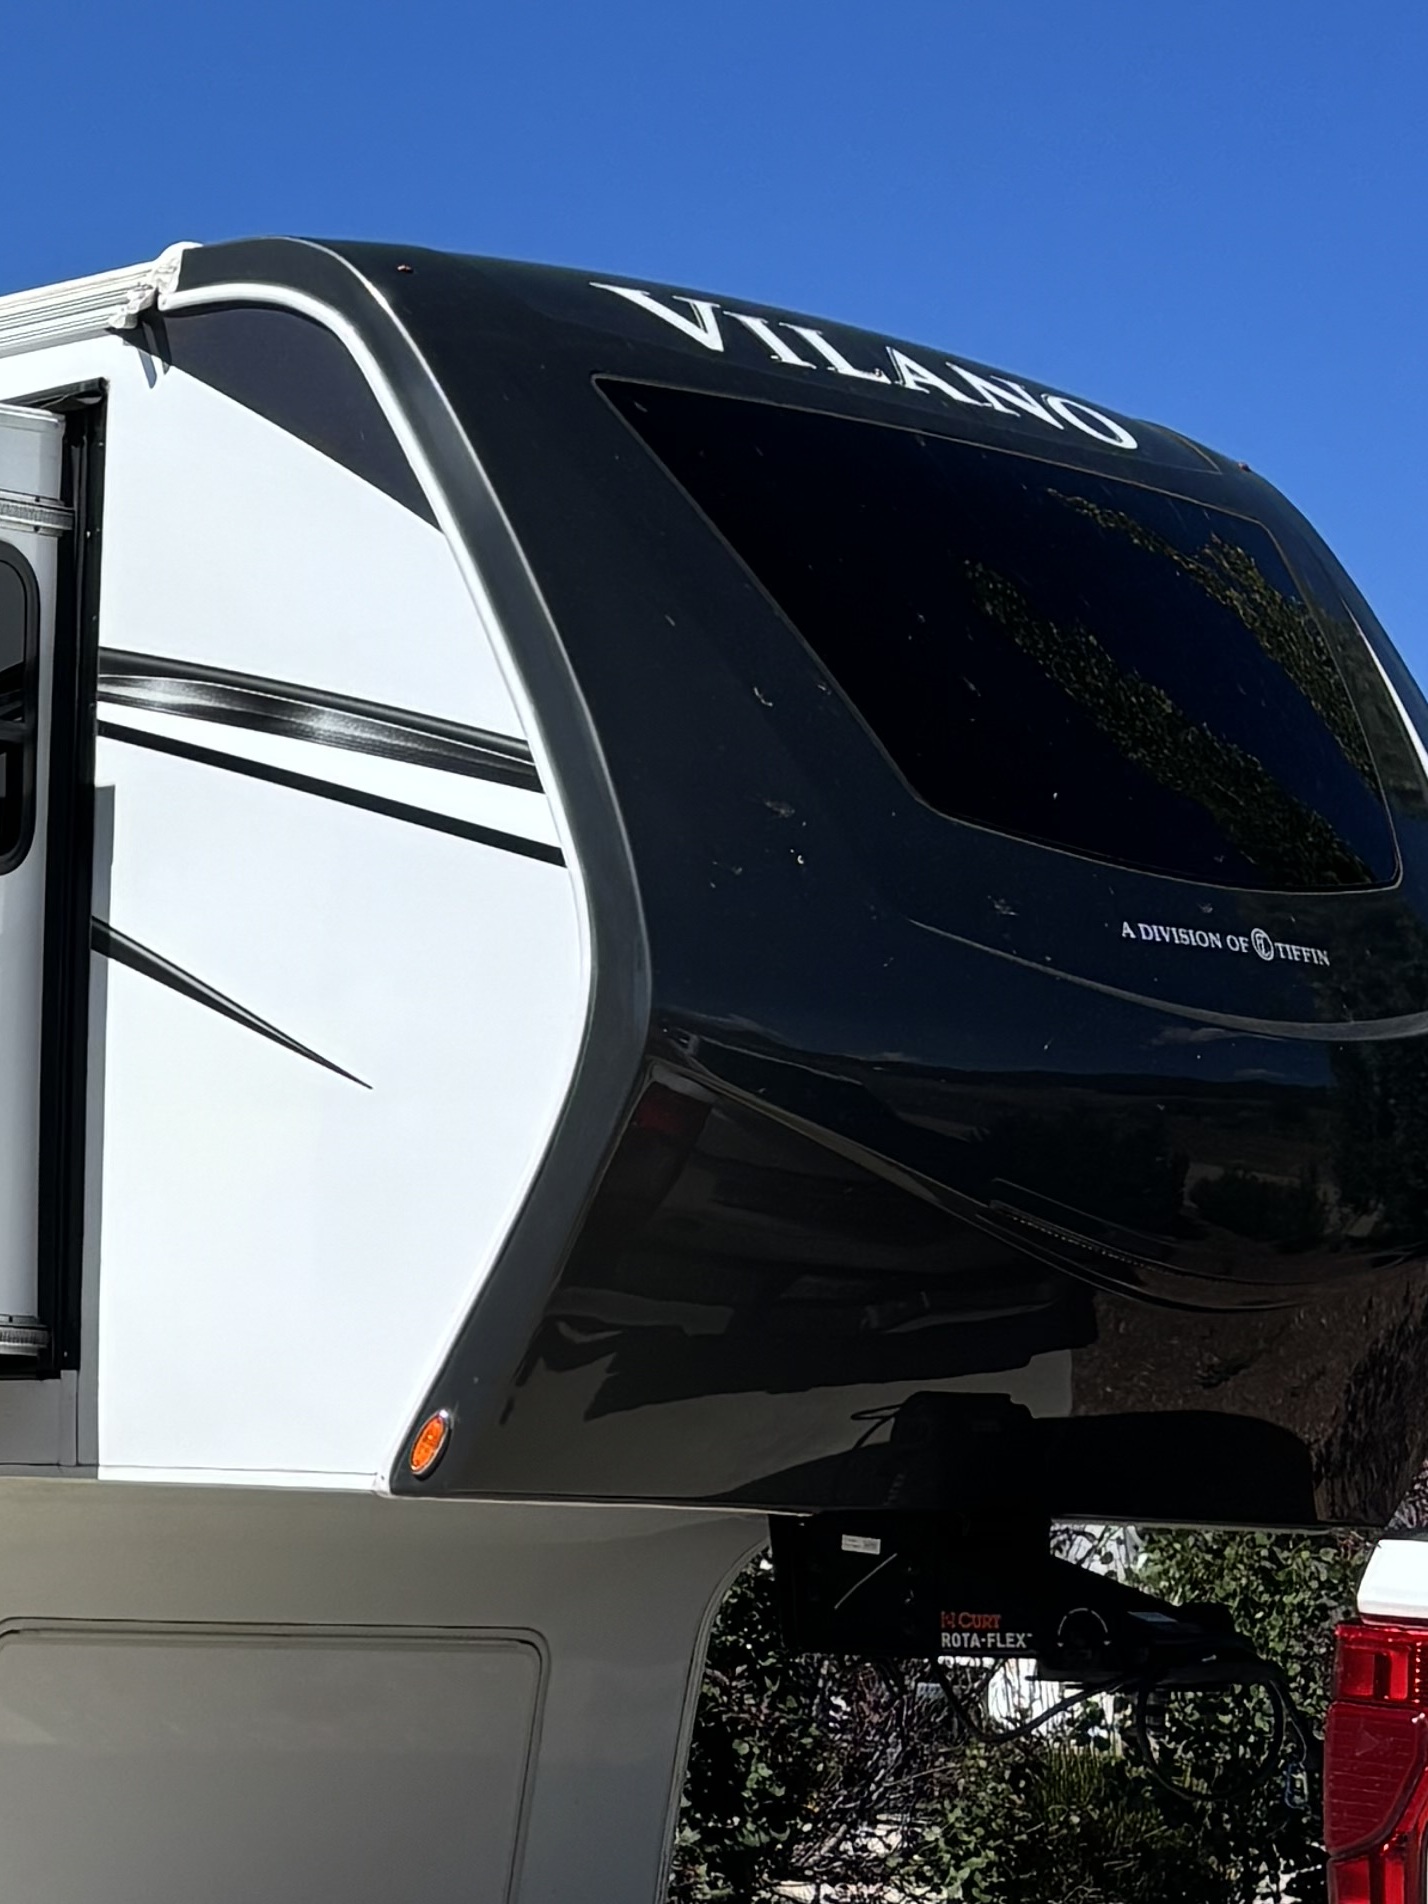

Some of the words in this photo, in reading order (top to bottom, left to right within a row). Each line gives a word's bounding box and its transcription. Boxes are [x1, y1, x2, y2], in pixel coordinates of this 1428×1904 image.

[589, 281, 1138, 450] VILANO
[1121, 921, 1136, 939] A
[1138, 923, 1223, 950] DIVISION
[1227, 934, 1249, 953] OF
[1274, 942, 1330, 967] TIFFIN
[958, 1611, 1001, 1629] CURT
